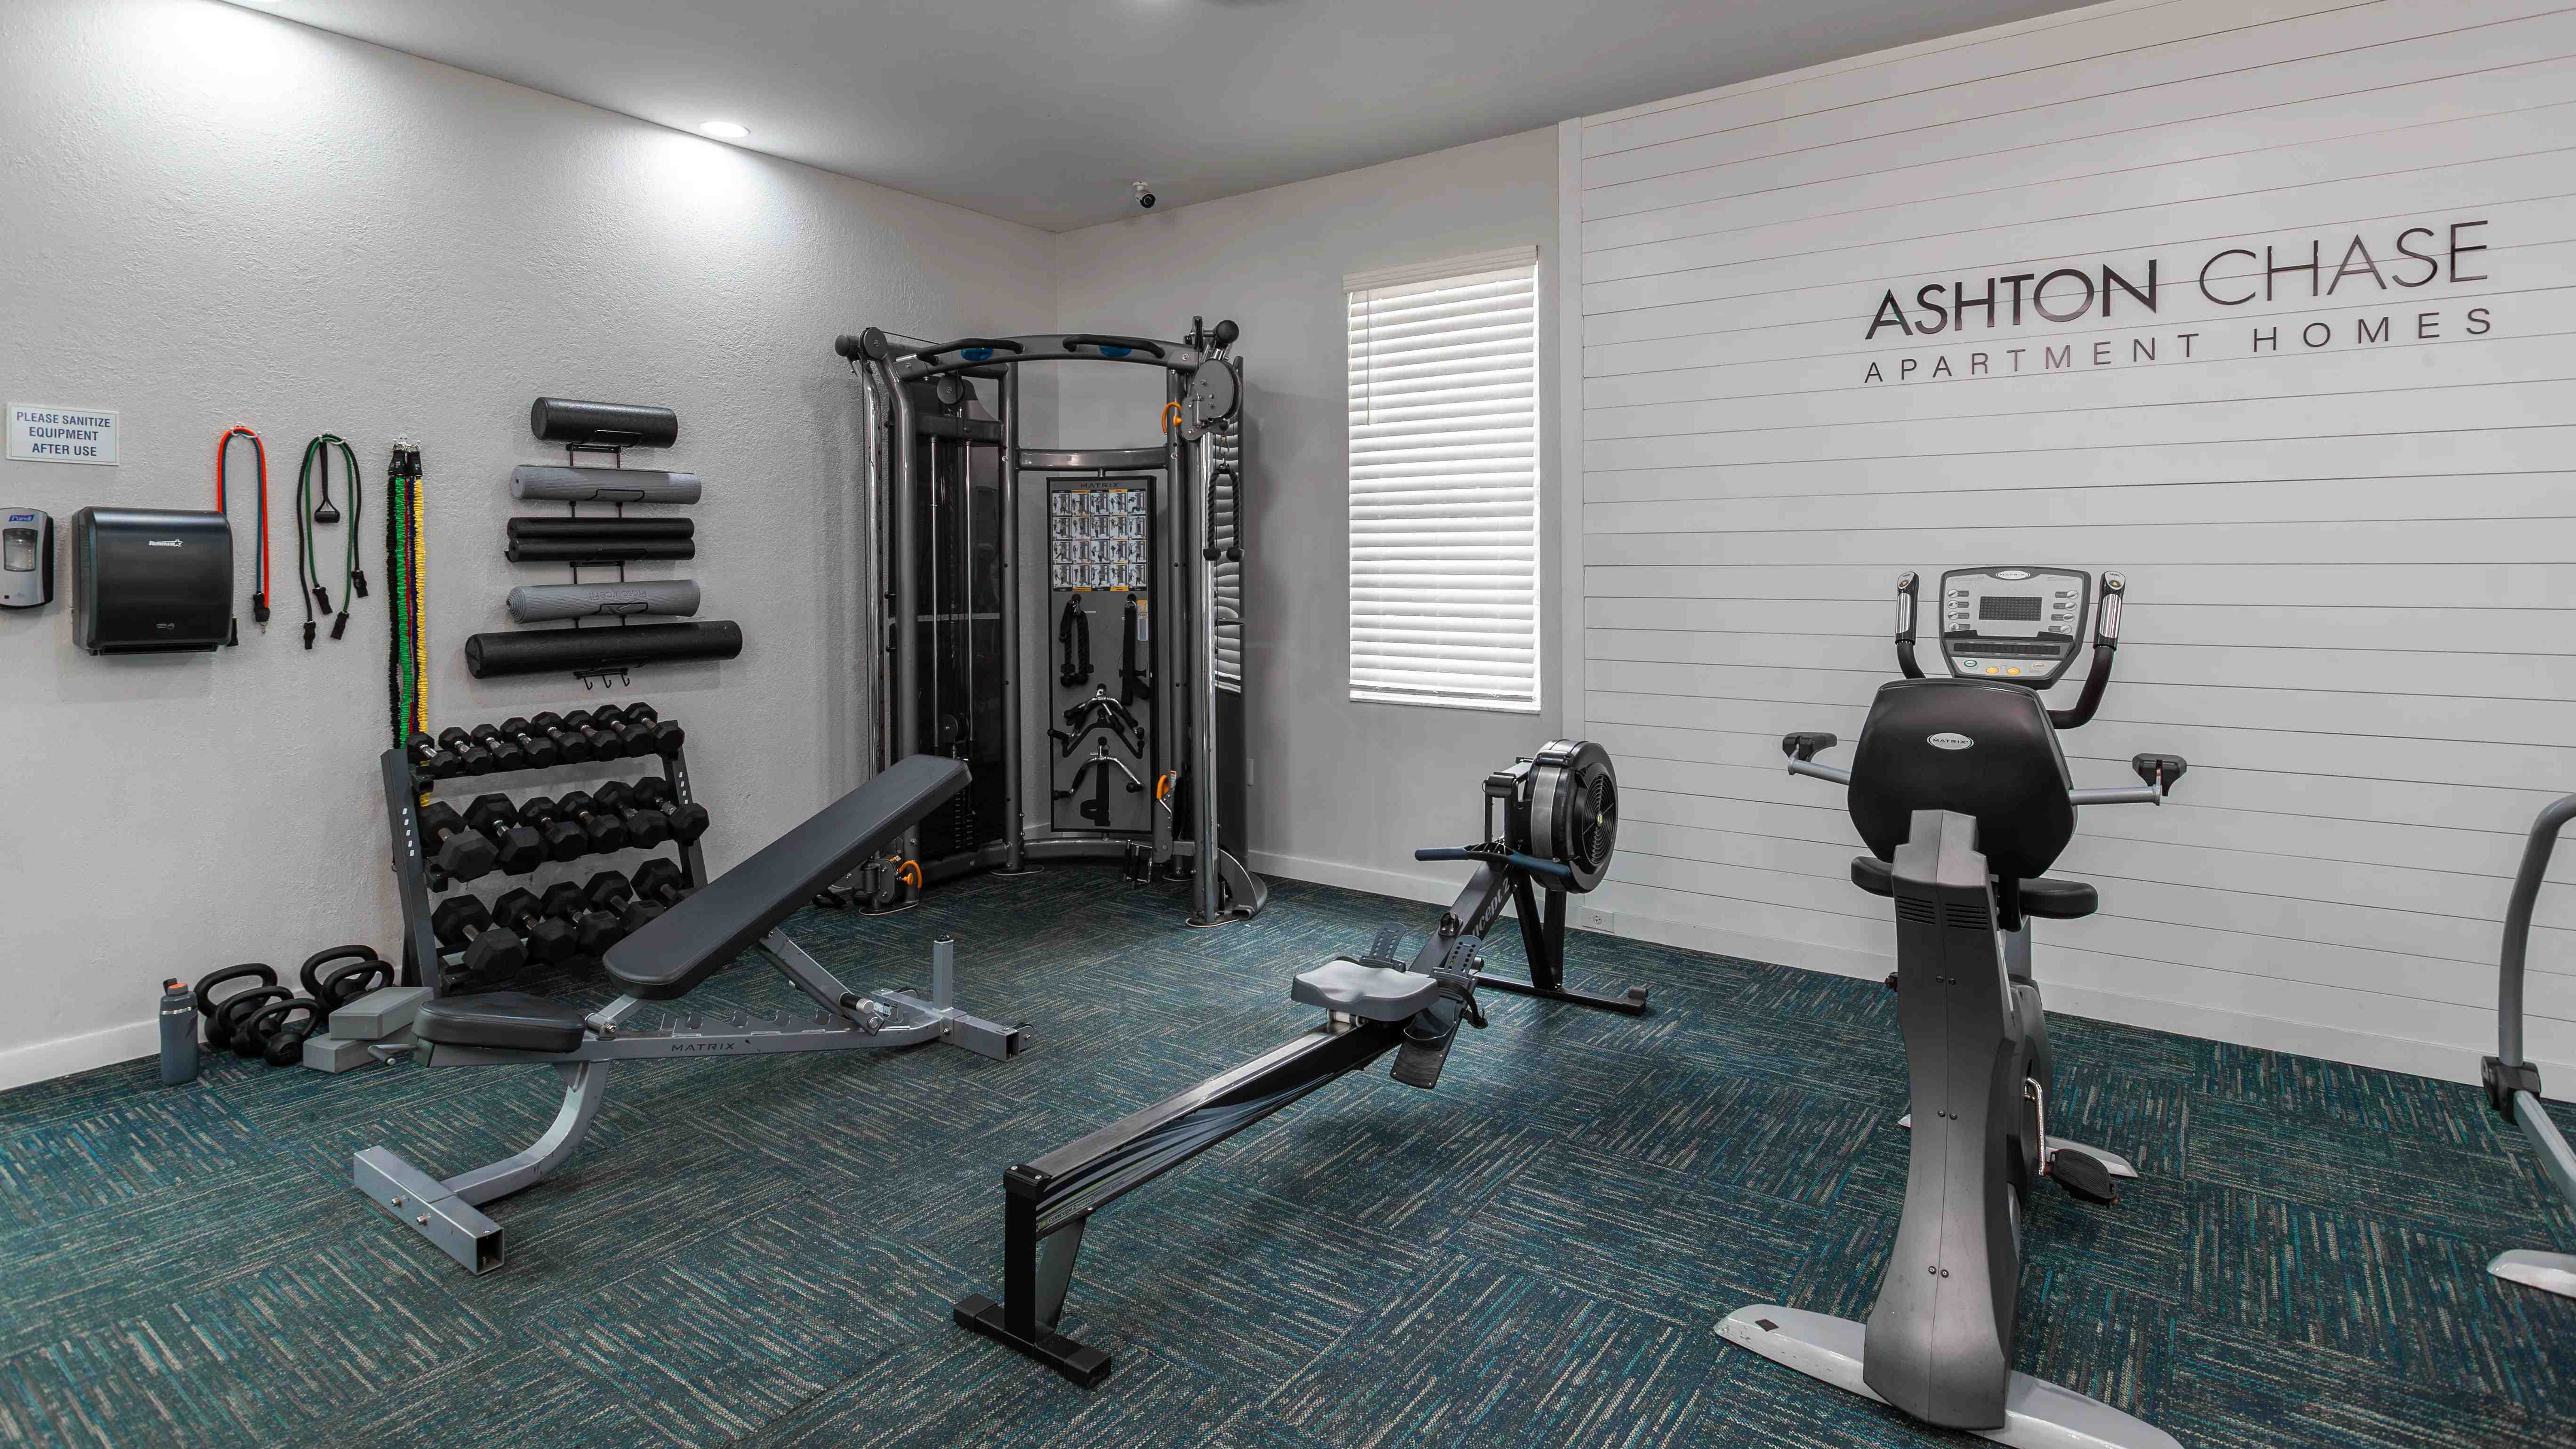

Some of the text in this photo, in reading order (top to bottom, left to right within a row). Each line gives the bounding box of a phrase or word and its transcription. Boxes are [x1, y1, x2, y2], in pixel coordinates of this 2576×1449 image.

[1865, 220, 2488, 339] ASHTON CHASE
[1864, 308, 2491, 384] APARTMENT HOMES
[16, 411, 111, 427] PLEASE SANITIZE
[29, 427, 98, 441] EQUIPMENT
[32, 443, 97, 456] AFTER USE
[1472, 877, 1510, 937] ncept 2
[671, 1043, 735, 1051] MATRIX
